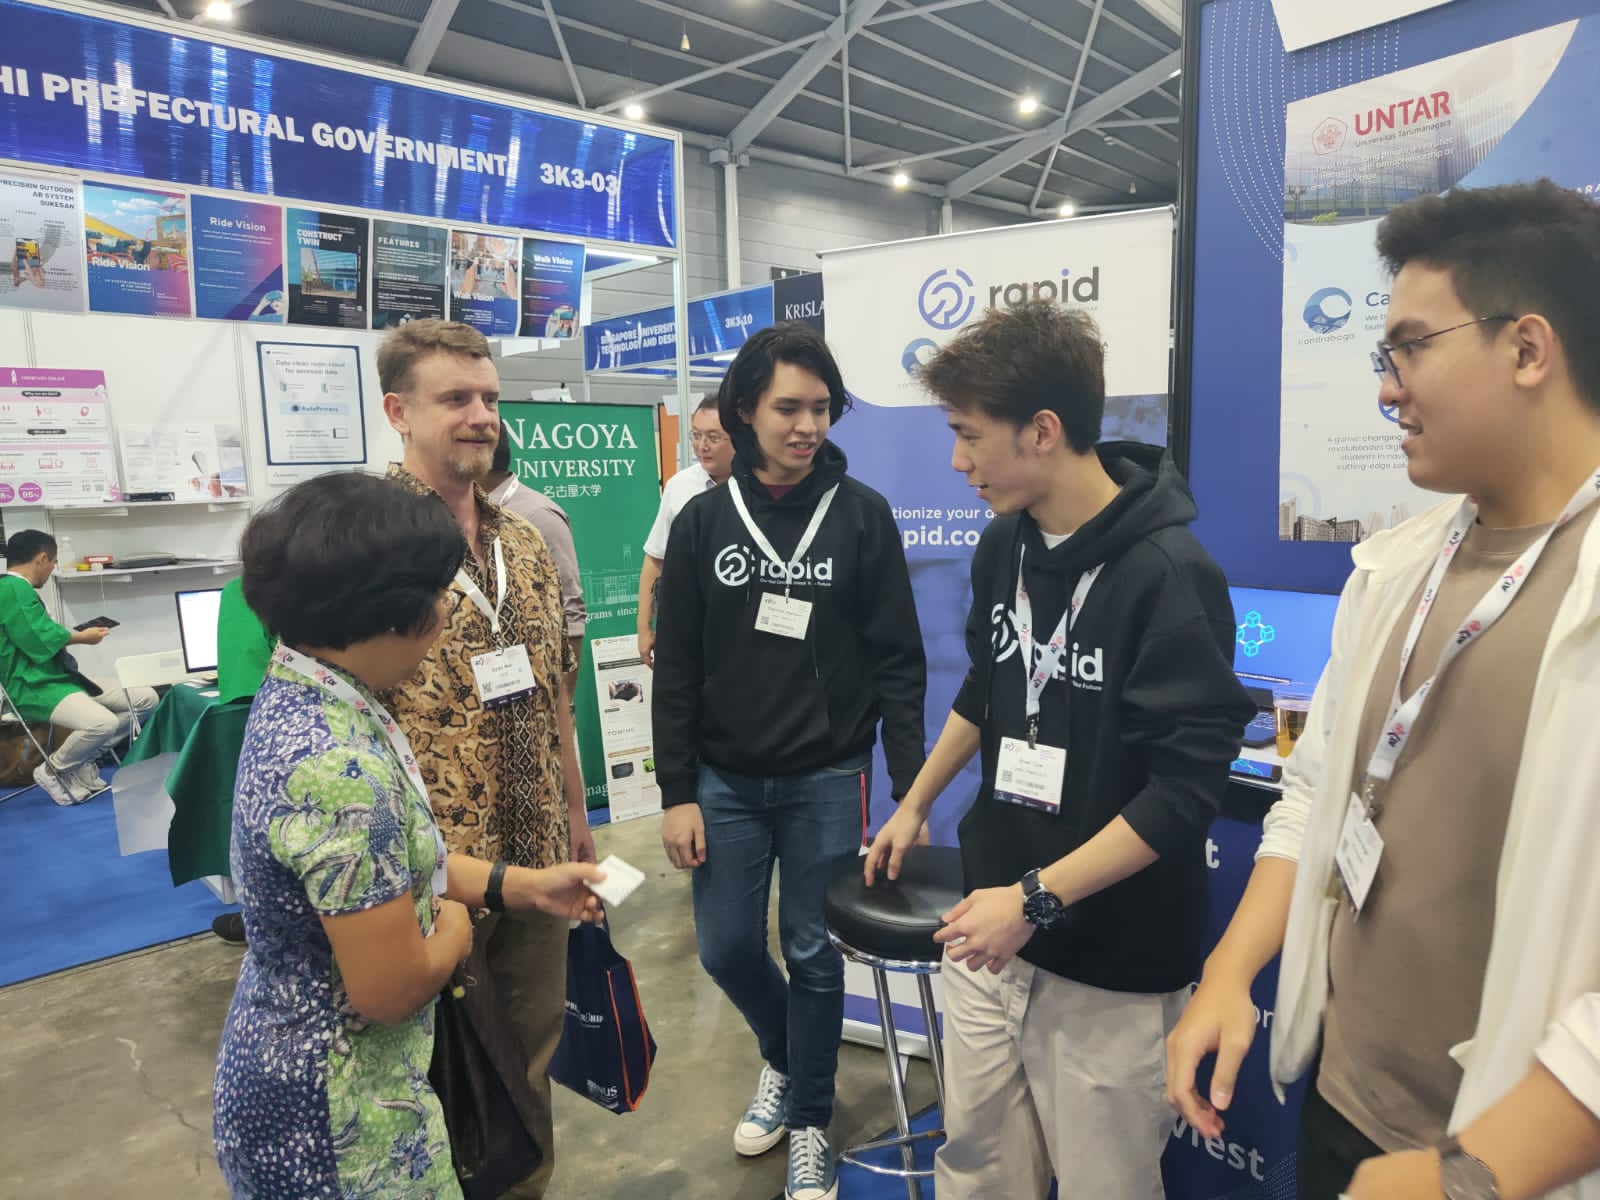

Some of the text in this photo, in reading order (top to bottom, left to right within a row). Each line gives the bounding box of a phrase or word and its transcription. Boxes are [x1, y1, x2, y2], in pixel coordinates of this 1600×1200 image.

[1354, 90, 1452, 136] UNTAR
[42, 72, 305, 143] PREFECTURAL
[311, 122, 508, 178] GOVERNMENT
[540, 162, 619, 195] 3K3-03
[0, 179, 74, 194] RECISION OUTDOOR
[45, 193, 74, 201] SYSTEM
[209, 216, 266, 232] Ride Vision
[296, 229, 343, 241] CONSTRUCT
[297, 237, 320, 246] TWIN
[378, 237, 420, 248] FEATURES
[91, 256, 151, 271] Ride Vision
[552, 256, 574, 265] Vision
[988, 266, 1100, 308] rapid
[642, 337, 658, 348] AND
[502, 417, 639, 449] NAGOYA
[543, 484, 602, 498] 名古屋大学
[892, 506, 942, 519] tionize
[946, 507, 981, 521] your
[903, 525, 980, 549] pid.co
[760, 556, 833, 580] rapid
[616, 607, 637, 617] since
